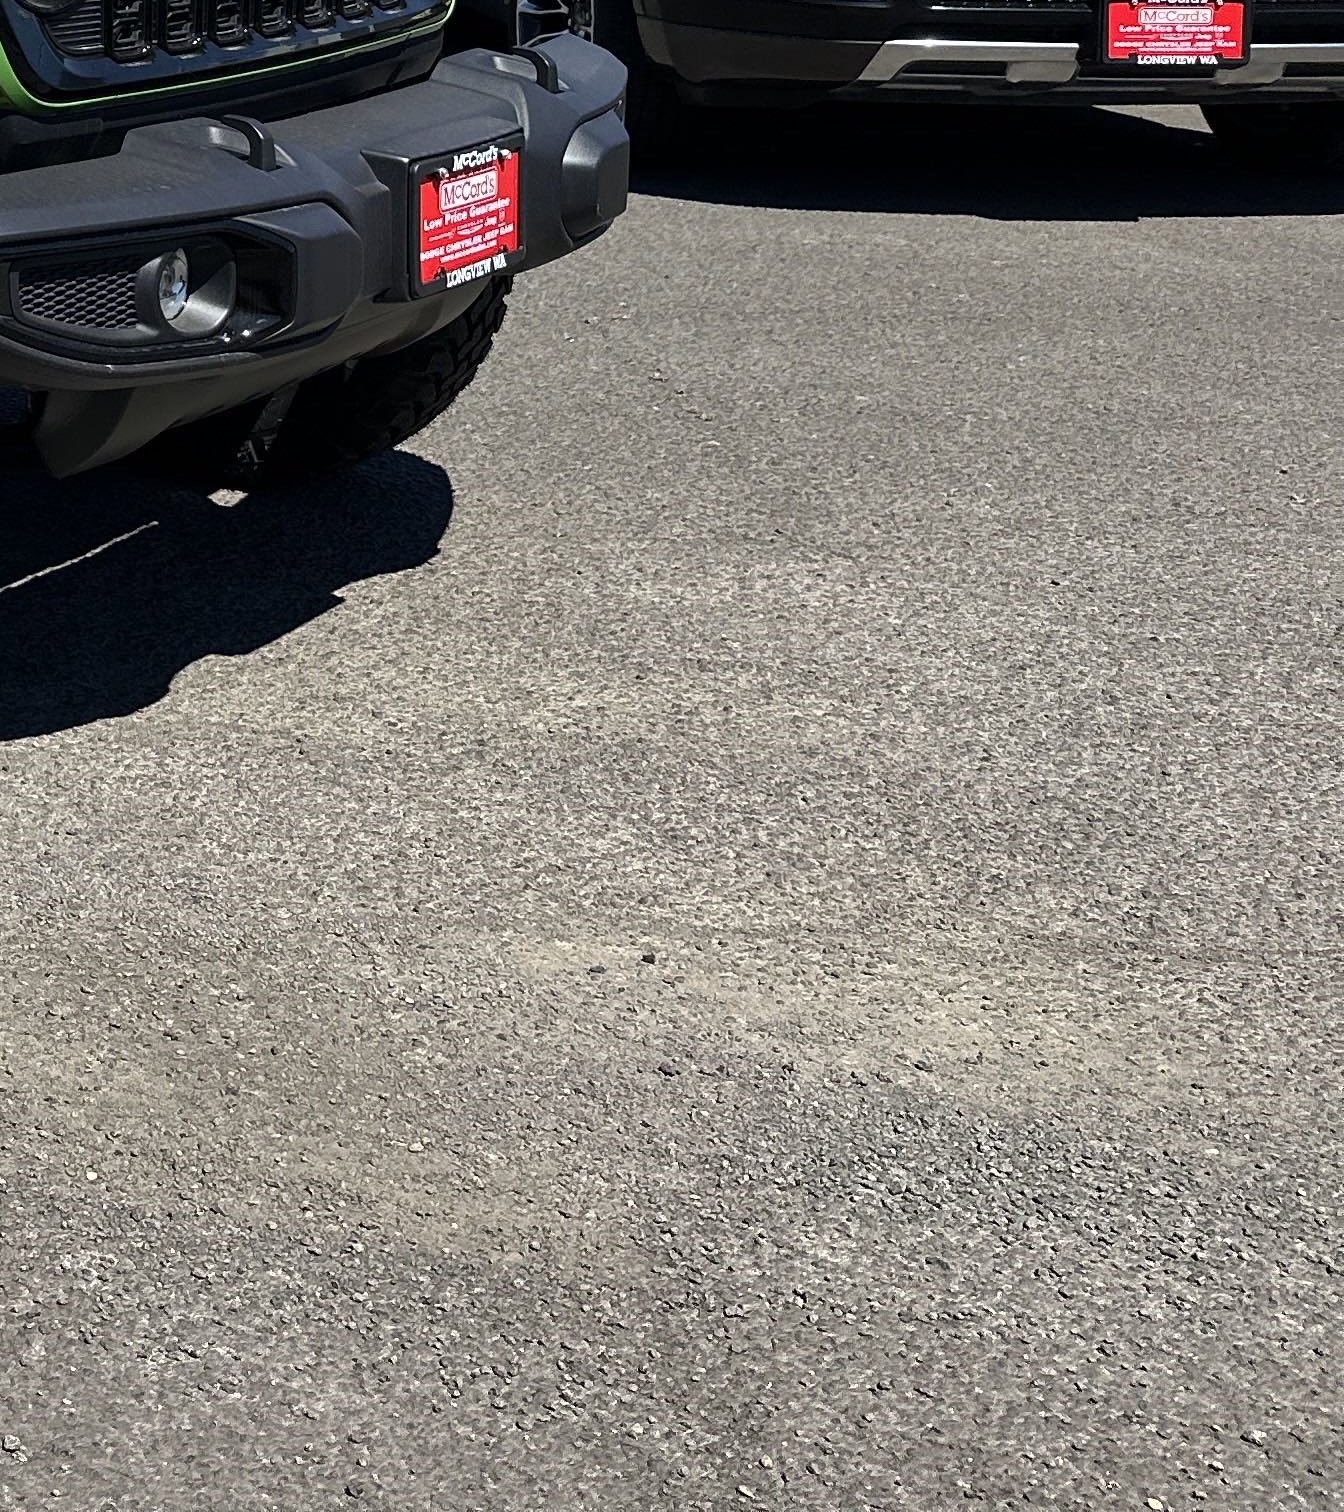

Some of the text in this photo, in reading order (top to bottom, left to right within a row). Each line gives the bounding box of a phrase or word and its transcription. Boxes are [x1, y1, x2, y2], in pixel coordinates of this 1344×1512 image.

[1143, 10, 1209, 22] McCord's
[1119, 24, 1143, 33] Low
[1144, 24, 1173, 33] Price
[1137, 55, 1219, 65] LONGVIEW WA
[452, 145, 499, 172] McCord's
[443, 174, 495, 207] McCord's
[423, 217, 444, 232] Low
[444, 210, 468, 226] Price
[446, 257, 492, 288] LONGVIEW
[492, 252, 507, 271] WA
